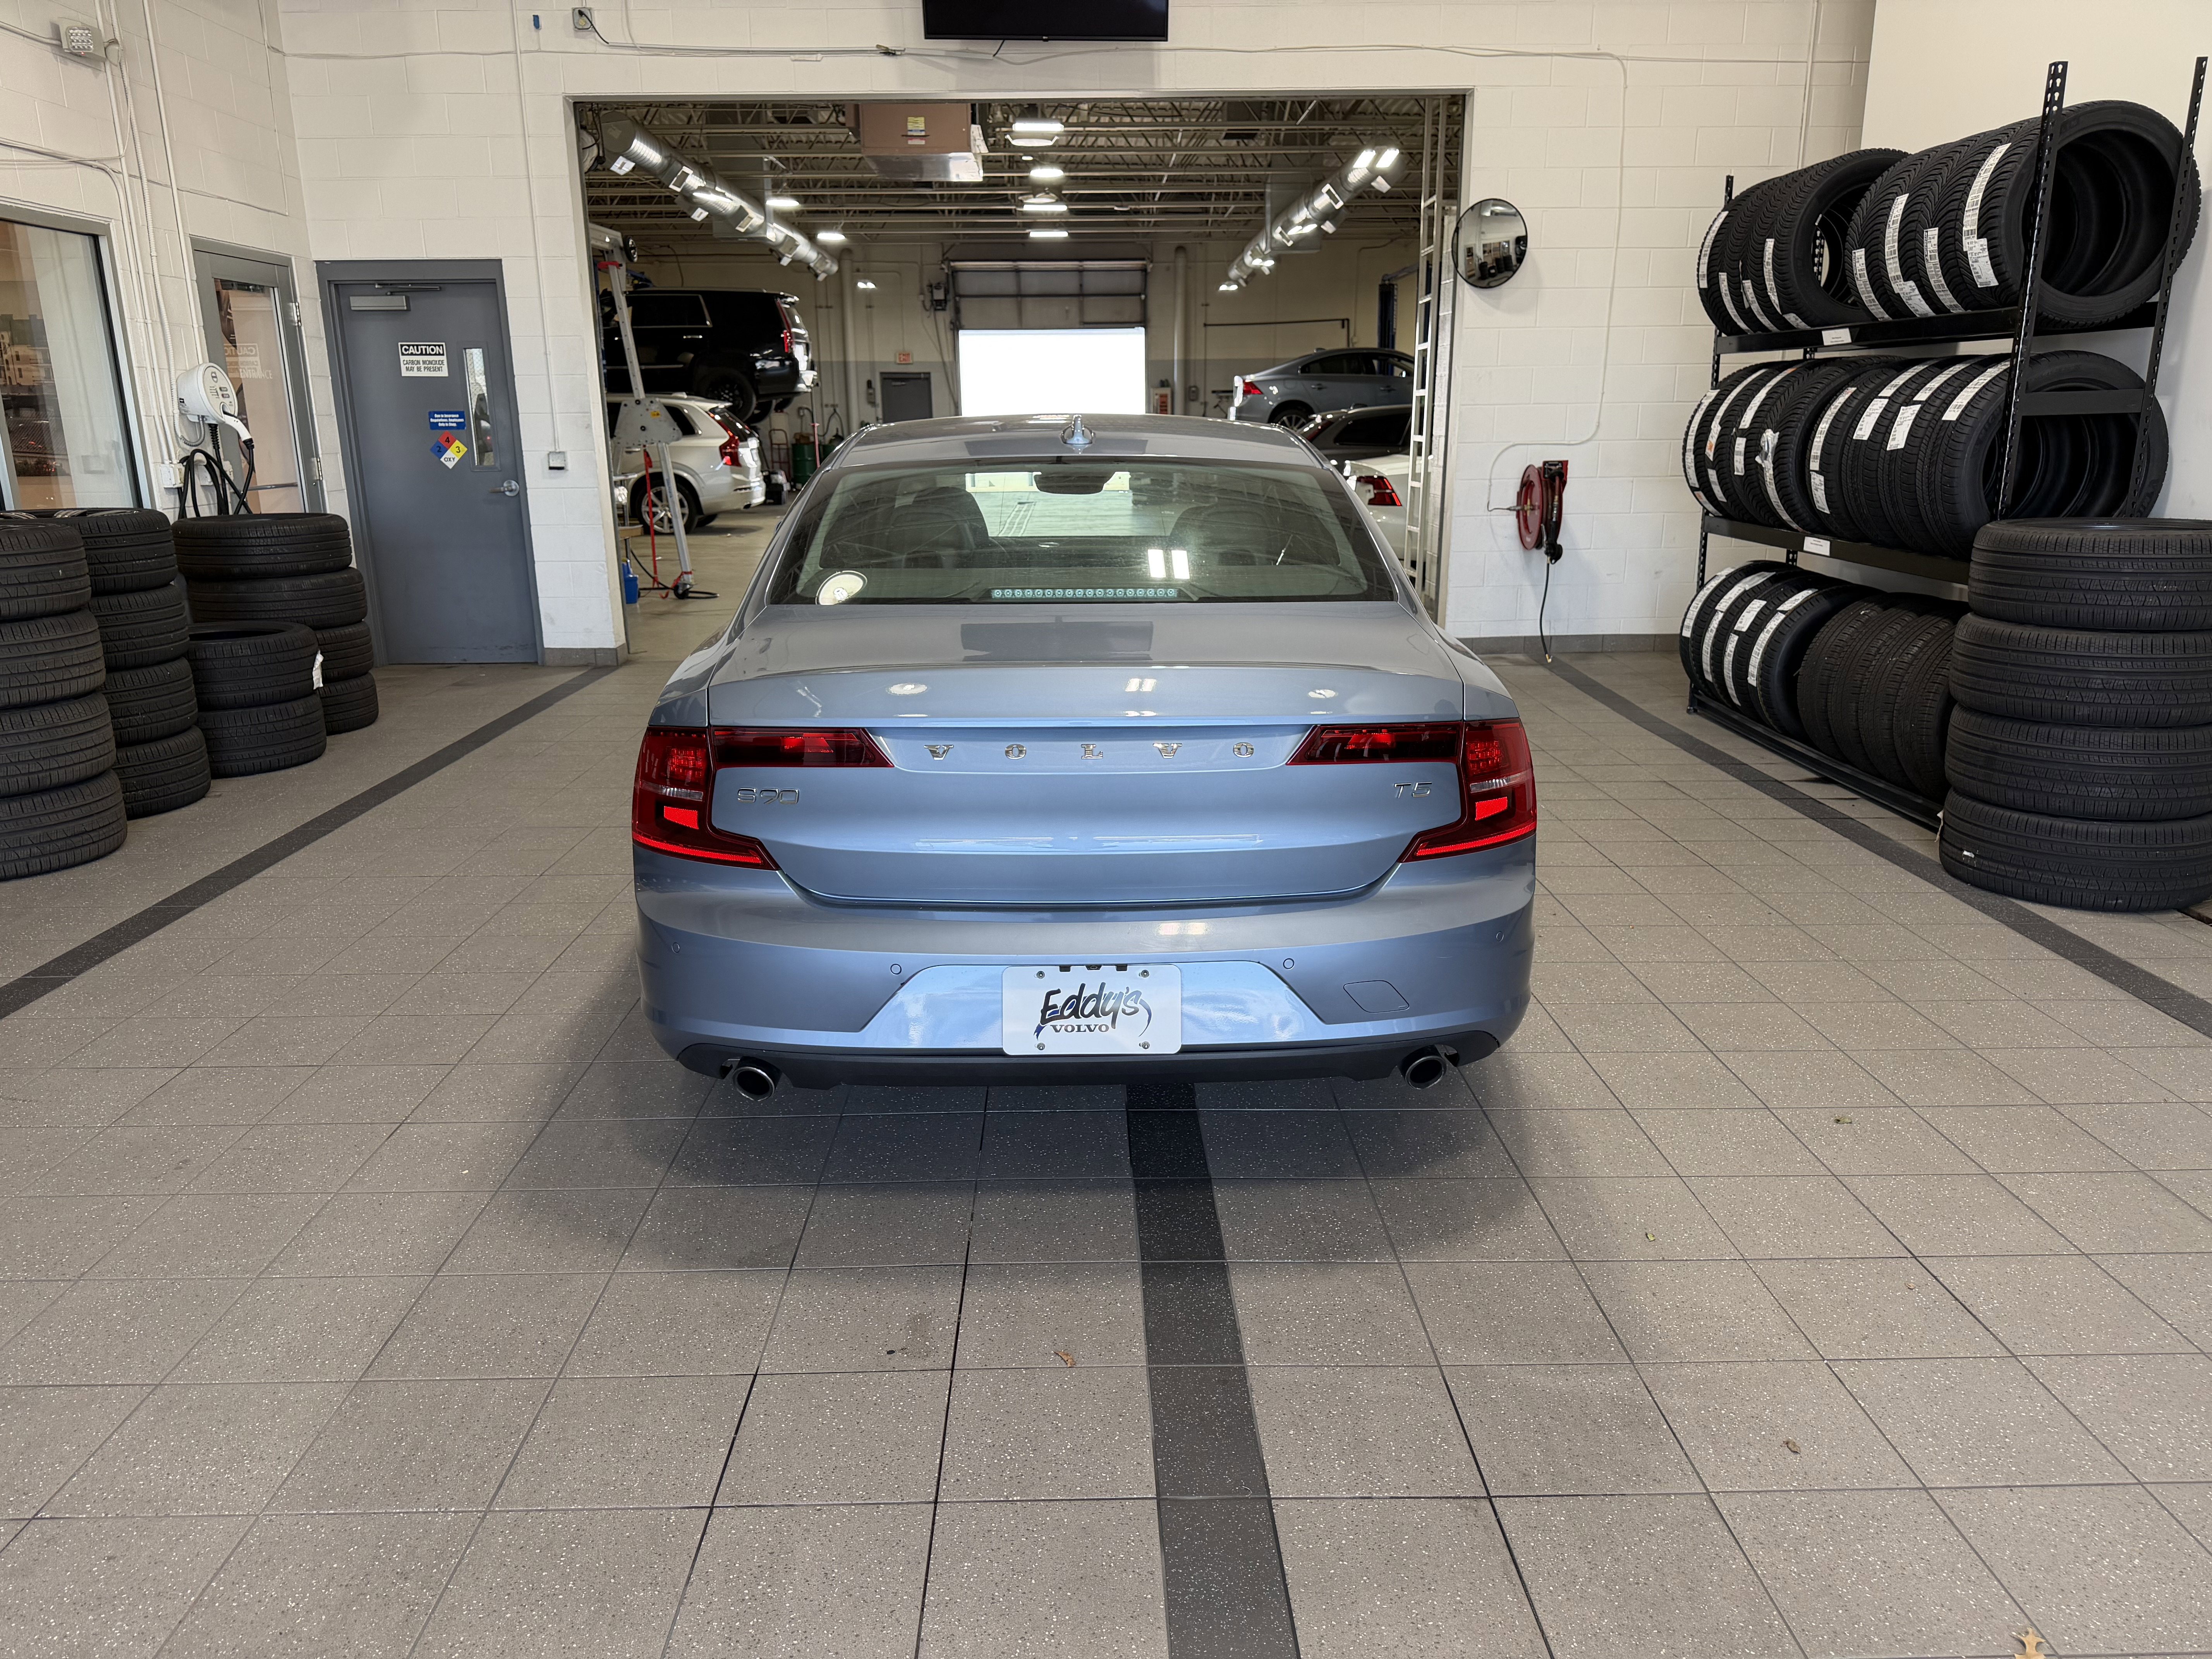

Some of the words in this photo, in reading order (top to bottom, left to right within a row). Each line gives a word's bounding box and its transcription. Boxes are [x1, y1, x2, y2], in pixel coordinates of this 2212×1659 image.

[402, 346, 443, 354] CAUTION
[240, 368, 273, 379] ENTRANCE
[924, 742, 1254, 760] VOLVO
[738, 787, 799, 804] S90
[1394, 781, 1432, 799] T5
[1040, 982, 1142, 1029] Eddy's
[1050, 1024, 1109, 1033] VOLVO
